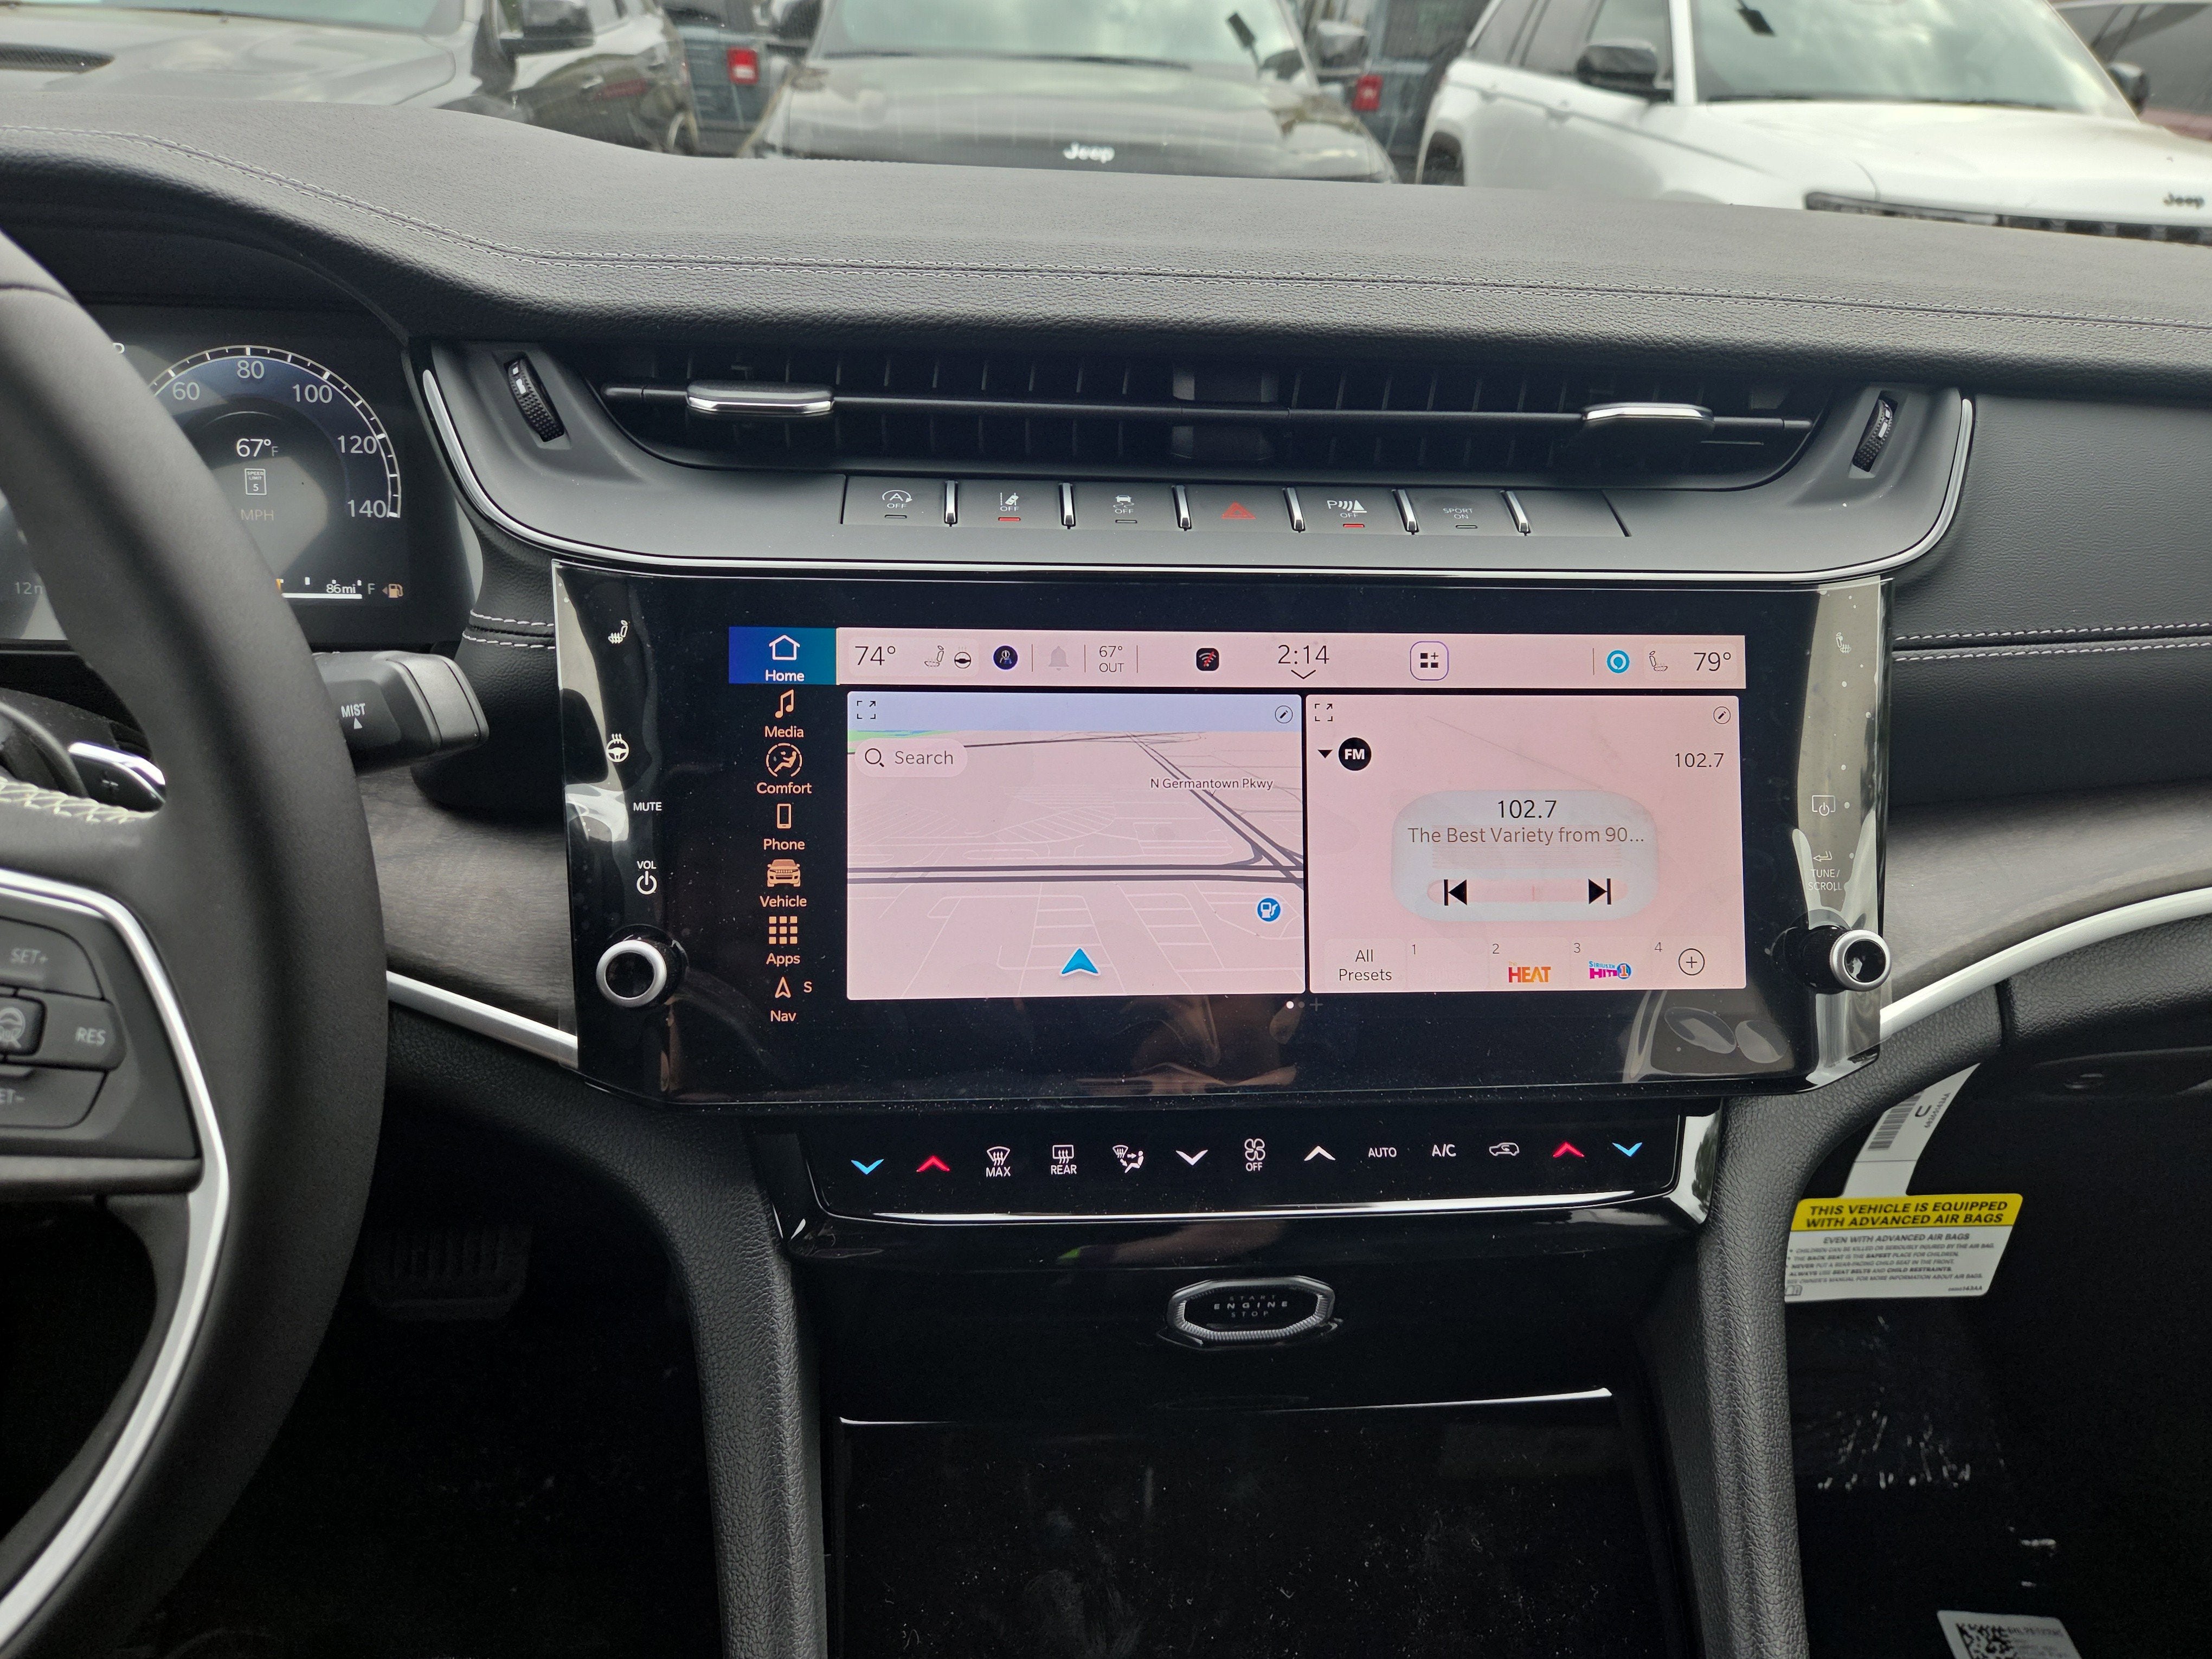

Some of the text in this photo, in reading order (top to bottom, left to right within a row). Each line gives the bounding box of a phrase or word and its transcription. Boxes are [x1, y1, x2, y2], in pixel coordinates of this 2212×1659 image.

[1063, 141, 1115, 163] Jeep
[236, 360, 265, 378] 80
[172, 381, 200, 400] 60
[292, 384, 332, 403] 100
[338, 436, 377, 454] 120
[253, 484, 259, 492] 5
[240, 509, 274, 521] MPH
[348, 499, 387, 518] 140
[326, 583, 375, 594] 86mi F
[855, 646, 896, 666] 74°
[1099, 645, 1123, 658] 67°
[1278, 645, 1329, 665] 2:14
[1099, 663, 1124, 673] OUT
[1694, 652, 1731, 671] 79°
[765, 670, 805, 682] Home
[341, 703, 365, 718] MIST
[764, 725, 804, 738] Media
[895, 750, 954, 765] Search
[1345, 749, 1365, 760] FM
[1675, 753, 1724, 768] 102.7
[756, 782, 812, 794] Comfort
[1150, 779, 1274, 791] N Germantown Pkwy
[633, 802, 662, 811] MUTE
[1498, 800, 1557, 818] 102.7
[1407, 827, 1441, 843] The
[1447, 827, 1486, 843] Best
[1490, 827, 1554, 846] Variety
[1559, 827, 1600, 842] from
[763, 838, 805, 851] Phone
[636, 860, 656, 869] VOL
[1811, 869, 1840, 878] TUNE/
[1808, 882, 1843, 891] SCROLL
[760, 896, 807, 908] Vehicle
[1412, 944, 1416, 955] 1
[1492, 943, 1500, 954] 2
[1574, 943, 1580, 953] 3
[1654, 942, 1663, 953] 4
[766, 953, 800, 967] Apps
[1355, 949, 1373, 962] All
[1339, 968, 1392, 981] Presets
[1508, 967, 1551, 983] HEAT
[803, 981, 812, 993] S
[770, 1011, 796, 1022] Nav
[75, 1027, 106, 1046] RES
[0, 1088, 25, 1105] ET-
[1368, 1147, 1397, 1158] AUTO
[1432, 1144, 1457, 1157] A/C
[986, 1167, 1011, 1177] MAX
[1051, 1165, 1077, 1175] REAR
[1245, 1162, 1263, 1172] OFF
[1810, 1201, 2008, 1216] THIS VEHICLE IS EQUIPPED
[1806, 1213, 2004, 1227] WITH ADVANCED AIR BAGS
[1823, 1236, 1847, 1244] EVEN
[1850, 1235, 1873, 1243] WITH
[1875, 1234, 1925, 1242] ADVANCED
[1214, 1301, 1288, 1310] ENGINE
